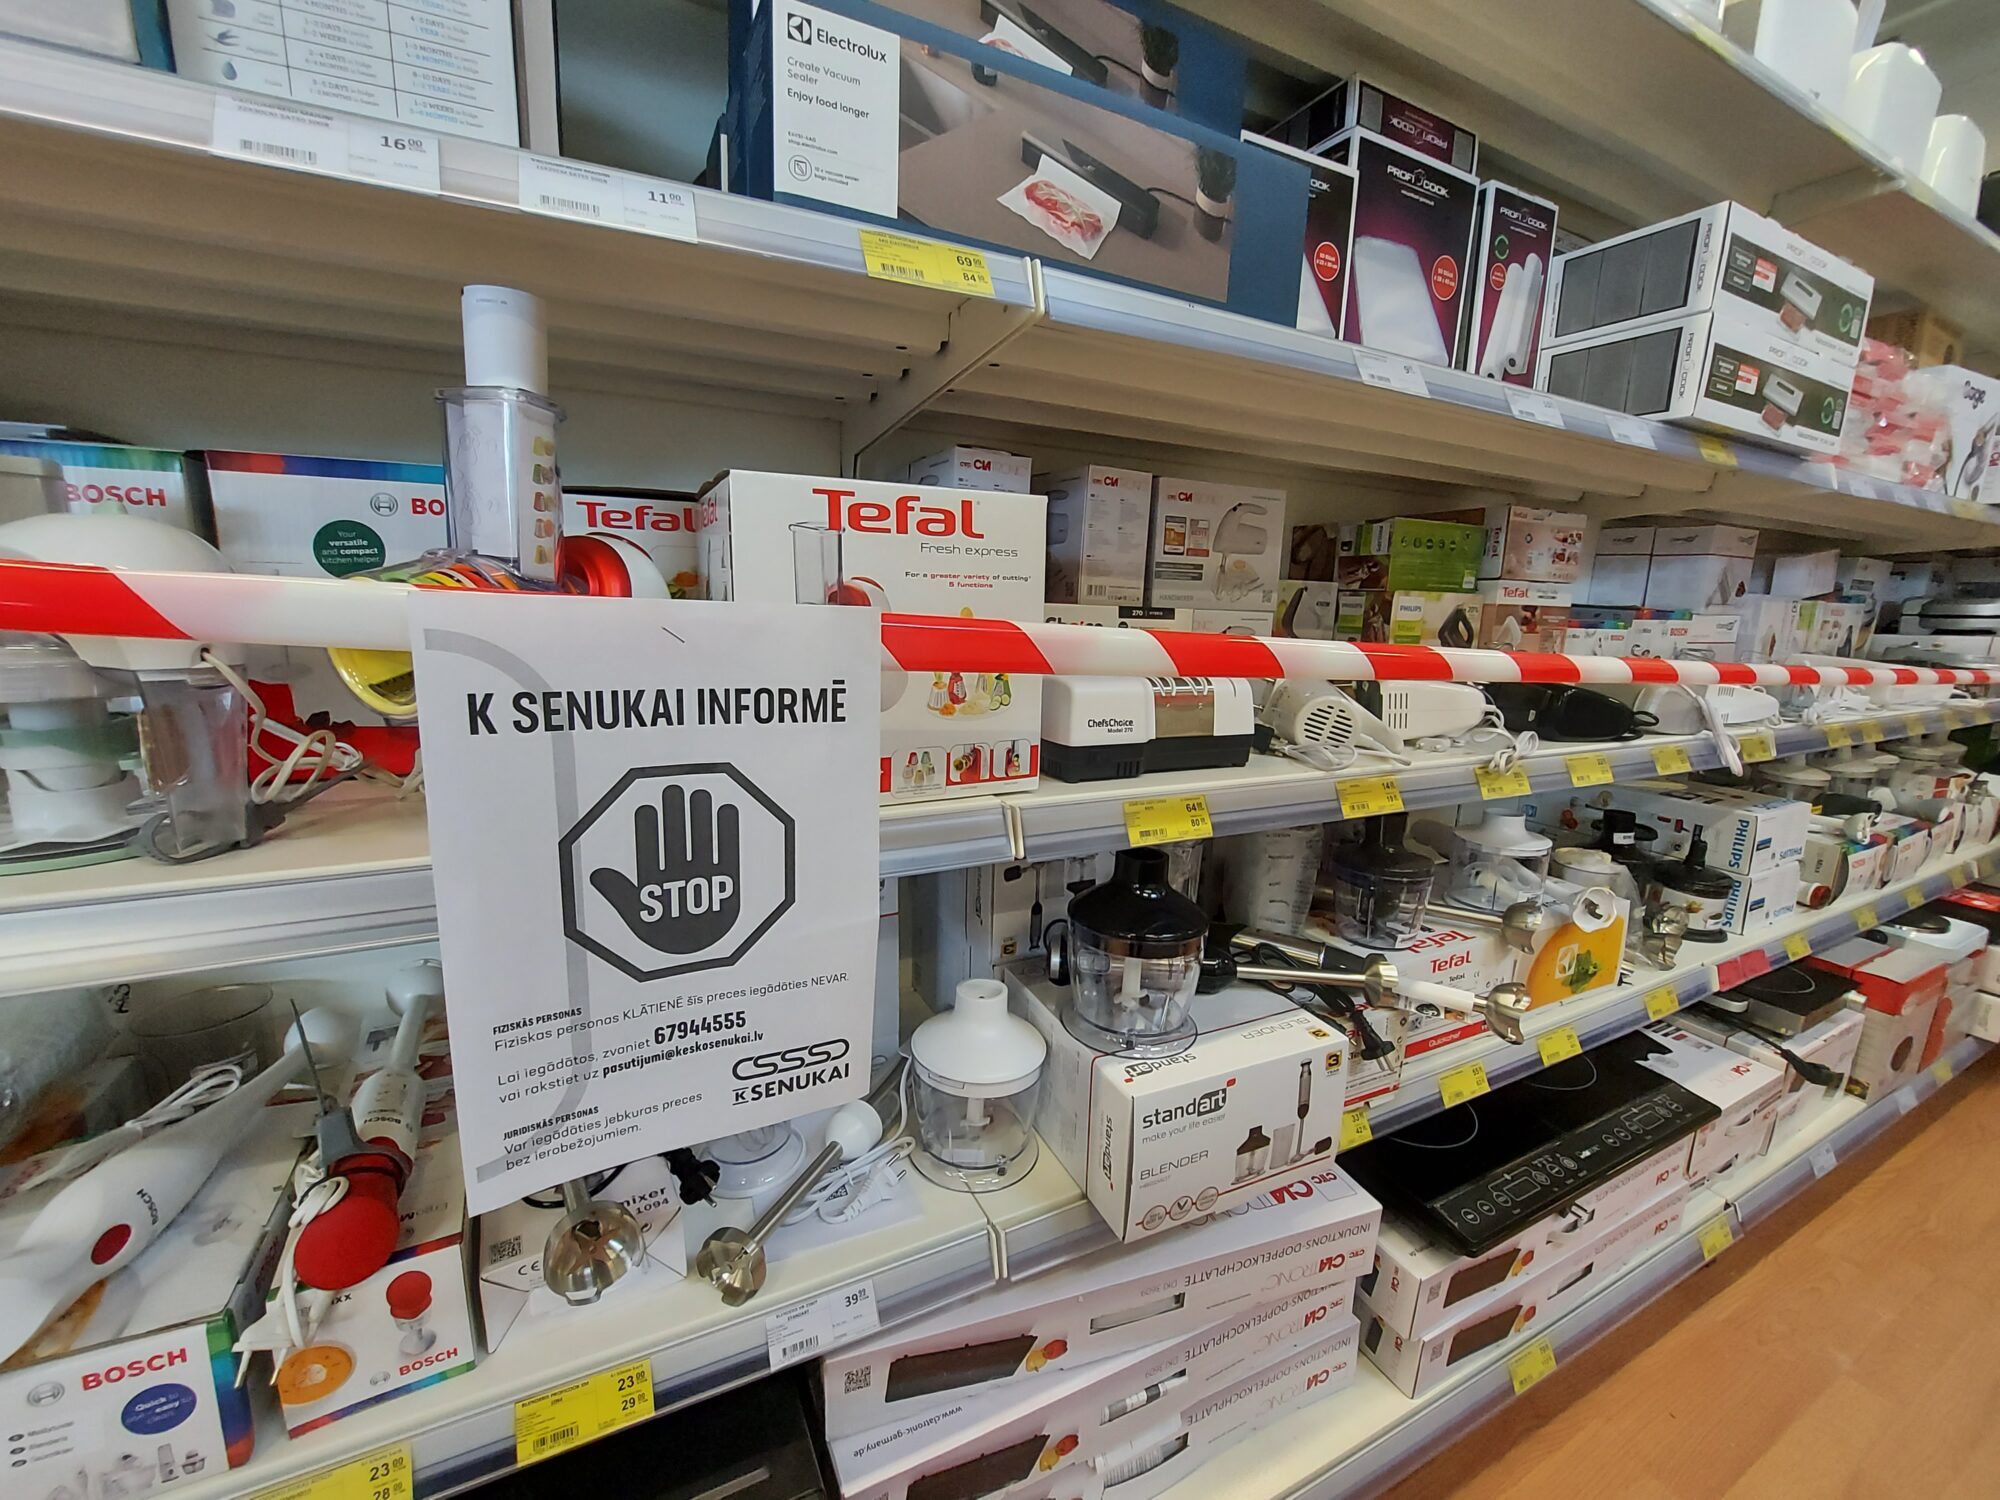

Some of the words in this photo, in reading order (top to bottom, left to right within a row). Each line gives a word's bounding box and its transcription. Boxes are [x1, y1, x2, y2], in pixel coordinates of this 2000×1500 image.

[816, 28, 887, 64] Electrolux
[787, 56, 820, 74] Create
[824, 66, 861, 86] Vacuum
[787, 69, 819, 85] Sealer
[787, 88, 813, 104] Enjoy
[816, 95, 838, 110] food
[840, 102, 869, 119] longer
[1386, 164, 1415, 183] PROFI
[1423, 181, 1451, 198] COOK
[64, 483, 167, 507] BOSCH
[577, 500, 697, 532] Tefal
[812, 488, 986, 540] Tefal
[337, 530, 356, 538] Your
[321, 556, 352, 564] kitchen
[340, 547, 378, 556] compact
[920, 542, 961, 555] Fresh
[965, 548, 1018, 558] express
[1502, 586, 1529, 598] Tefal
[467, 693, 498, 735] K
[512, 688, 685, 734] SENUKAI
[697, 680, 847, 725] INFORMĒ
[1729, 819, 1750, 869] PHILIPS
[639, 875, 734, 922] STOP
[1430, 951, 1472, 973] Tefal
[1449, 973, 1465, 982] Tefal
[493, 1018, 534, 1035] FIZISKĀS
[536, 1007, 582, 1025] PERSONAS
[495, 1030, 552, 1051] Fiziskas
[557, 1014, 619, 1039] personas
[622, 995, 684, 1021] KLĀTIENĒ
[687, 994, 704, 1006] šīs
[706, 988, 746, 1005] preces
[750, 981, 808, 998] iegādāties
[811, 972, 849, 987] NEVAR.
[1240, 1017, 1311, 1039] BLENDER
[498, 1070, 520, 1086] Lai
[525, 1053, 598, 1078] iegādātos,
[603, 1039, 650, 1059] zvaniet
[654, 1010, 746, 1045] 67944555
[1328, 1053, 1340, 1067] 3
[499, 1090, 520, 1103] vai
[525, 1074, 579, 1096] rakstiet
[583, 1069, 599, 1081] uz
[603, 1031, 764, 1079] pasutijumi@keskosenukai.lv
[1126, 1052, 1197, 1077] standart
[364, 1116, 401, 1124] BOSCH
[503, 1118, 554, 1140] JURIDISKĀS
[555, 1106, 599, 1124] PERSONAS
[504, 1140, 528, 1154] Var
[532, 1119, 601, 1147] iegādāties
[604, 1105, 659, 1129] jebkuras
[662, 1093, 703, 1111] preces
[1142, 1087, 1227, 1129] standart
[1142, 1131, 1166, 1145] make
[1168, 1125, 1187, 1138] your
[1188, 1120, 1200, 1130] life
[1202, 1113, 1226, 1125] easier
[506, 1154, 531, 1171] bez
[535, 1123, 642, 1162] ierobežojumiem.
[1140, 1150, 1209, 1181] BLENDER
[136, 1188, 158, 1225] BOSCH
[635, 1198, 670, 1215] 1094
[1184, 1222, 1371, 1287] INDUKTIONS-DOPPELKOCHPLATTE
[81, 1348, 188, 1391] BOSCH
[399, 1347, 458, 1376] BOSCH
[1187, 1336, 1352, 1426] INDUKTIONS-DOPPELKOCHPLATTE
[135, 1397, 166, 1412] Quick
[853, 1405, 963, 1457] www.clatronic-germany.de
